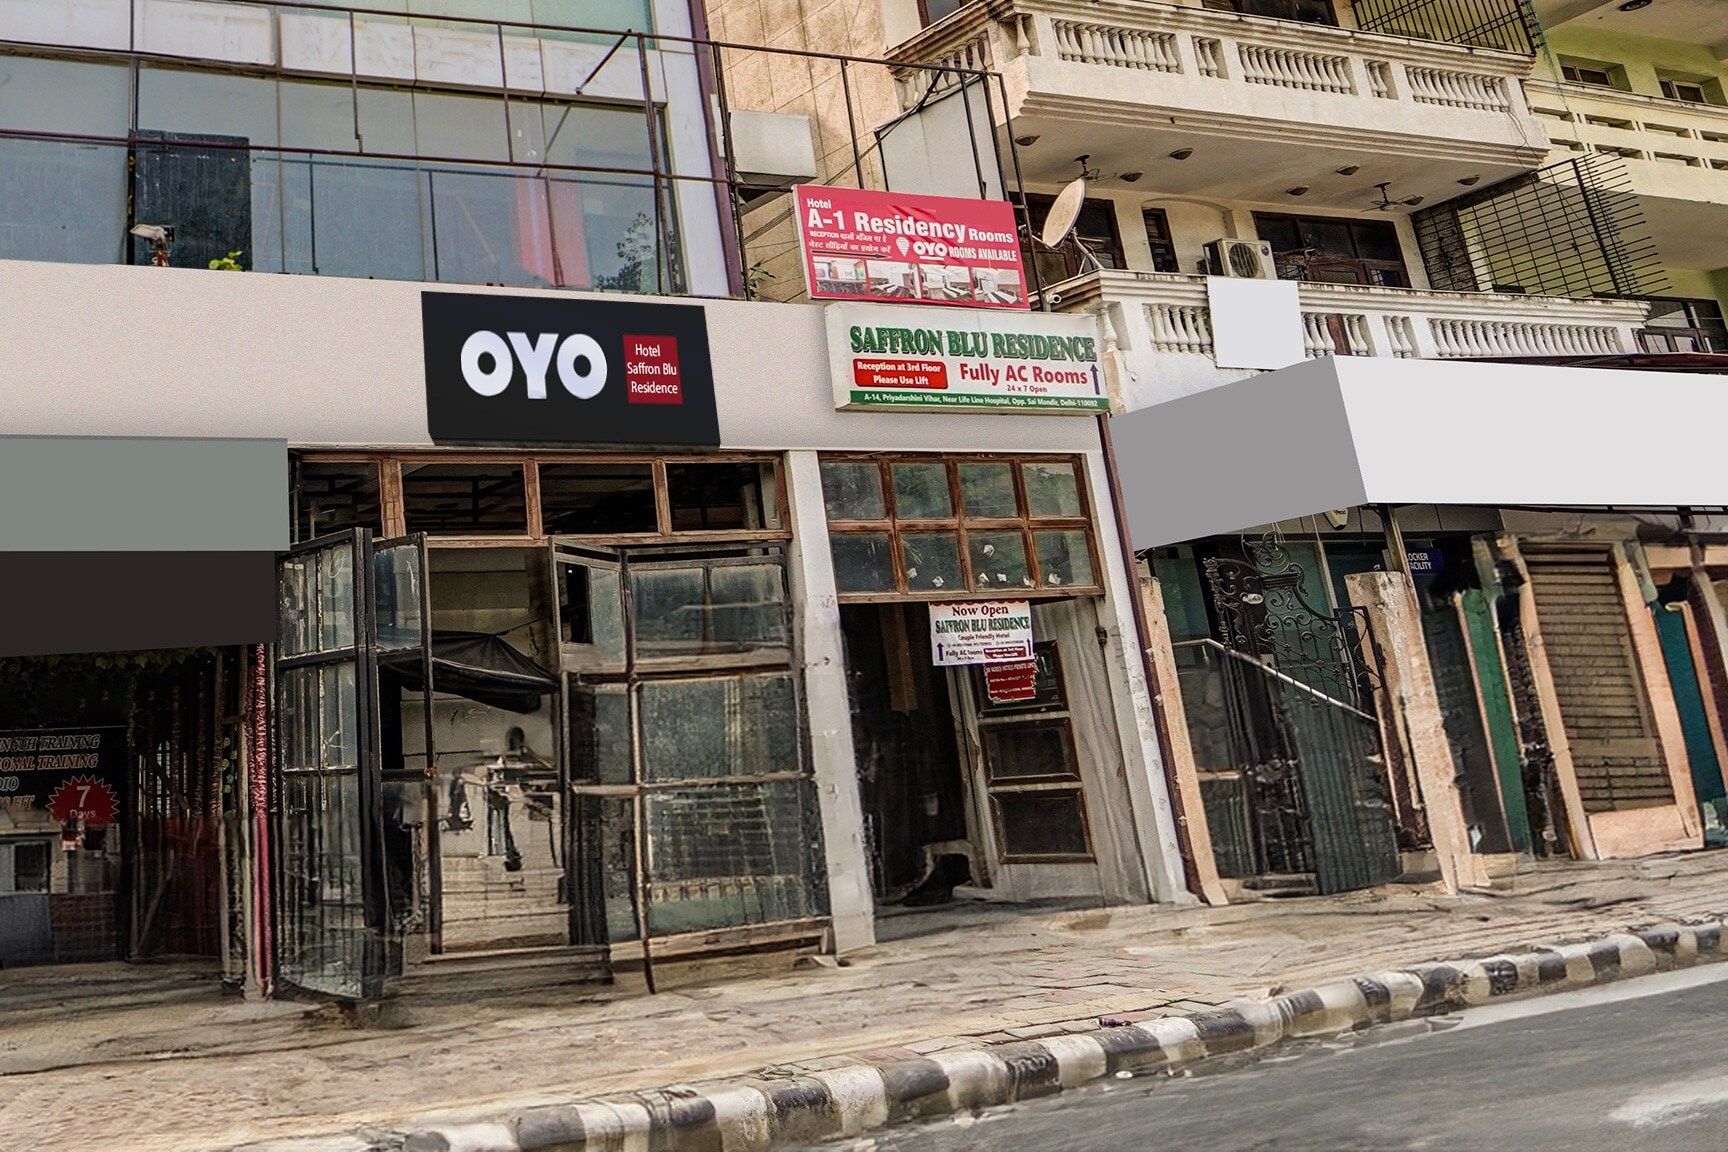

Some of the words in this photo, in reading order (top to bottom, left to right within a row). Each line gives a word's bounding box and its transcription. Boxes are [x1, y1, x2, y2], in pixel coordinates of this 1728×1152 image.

[807, 198, 831, 208] Hotel
[808, 208, 845, 230] A-1
[854, 211, 966, 244] Residency
[968, 228, 1014, 243] Rooms
[913, 241, 947, 257] OYO
[948, 246, 977, 259] ROOMS
[978, 248, 1017, 261] AVAILABLE
[635, 343, 661, 357] Hotel
[850, 325, 944, 356] SAFFRON
[946, 330, 988, 358] BLU
[991, 333, 1097, 362] RESIDENCE
[461, 330, 608, 399] OYO
[627, 361, 661, 375] Saffron
[662, 362, 677, 376] Blu
[857, 361, 896, 372] Reception
[897, 363, 906, 371] at
[906, 363, 920, 372] 3rd
[921, 364, 942, 373] Floor
[873, 375, 898, 384] Please
[899, 376, 914, 384] Use
[915, 376, 929, 385] Lift
[960, 363, 999, 386] Fully
[1005, 365, 1028, 382] AC
[1032, 366, 1088, 384] Rooms
[631, 380, 678, 394] Residence
[1029, 386, 1048, 394] Open
[864, 393, 881, 402] A-14,
[882, 393, 923, 403] Priyadarshini
[923, 394, 941, 403] Vihar,
[942, 395, 957, 403] Near
[971, 396, 984, 404] Line
[984, 397, 1011, 405] Hospital,
[1012, 398, 1025, 406] Opp.
[1060, 399, 1098, 407] Delhi-110092
[952, 606, 978, 616] Now
[981, 605, 1009, 617] Open
[935, 619, 970, 633] SAFFRON
[971, 618, 987, 632] BLU
[988, 616, 1030, 631] RESIDENCE
[975, 633, 994, 641] Friendly
[946, 649, 959, 657] Fully
[39, 734, 101, 751] TRAINING
[37, 753, 99, 771] TRAINING
[77, 786, 91, 807] 7
[70, 809, 97, 819] Days
